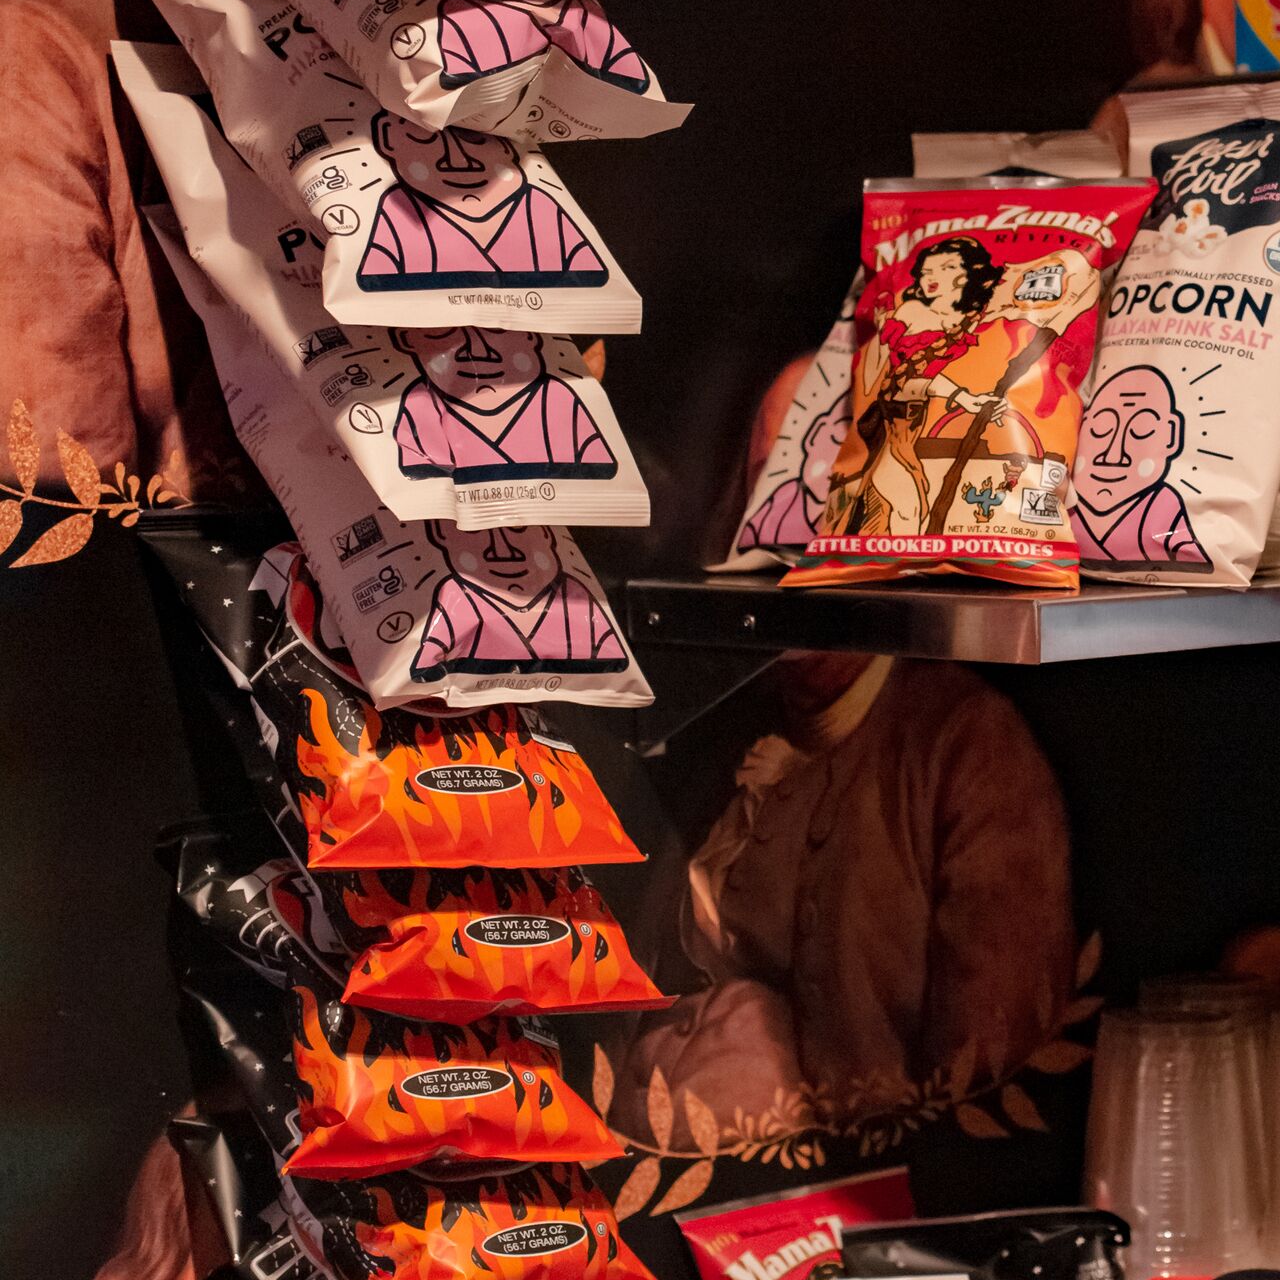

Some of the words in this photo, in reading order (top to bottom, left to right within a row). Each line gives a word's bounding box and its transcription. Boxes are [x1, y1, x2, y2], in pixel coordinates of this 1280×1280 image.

[1165, 269, 1214, 281] MINIMALLY
[1216, 271, 1274, 288] PROCESSED
[1108, 280, 1274, 328] OPCORN
[1164, 317, 1216, 338] PINK
[1219, 323, 1273, 350] SALT
[1125, 337, 1150, 346] EXTRA
[1151, 337, 1182, 347] VIRGIN
[1184, 338, 1234, 356] COCONUT
[1236, 347, 1255, 361] OIL
[324, 372, 349, 397] GLUTEN
[327, 388, 343, 403] FREE
[516, 485, 537, 500] (25g)
[948, 524, 964, 534] NET
[967, 525, 982, 534] WT.
[984, 526, 991, 534] 2
[992, 526, 1008, 535] OZ.
[1010, 526, 1039, 538] (56.7g)
[869, 538, 946, 554] COOKED
[952, 539, 1054, 557] POTATOES
[356, 582, 382, 601] GLUTEN
[359, 597, 376, 610] FREE
[431, 770, 454, 779] NET
[456, 770, 473, 778] WT.
[477, 770, 482, 778] 2
[485, 770, 502, 778] OZ.
[436, 780, 461, 789] (56.7
[463, 779, 504, 788] GRAMS)
[480, 921, 502, 929] NET
[504, 921, 522, 929] WT.
[524, 920, 530, 929] 2
[532, 920, 550, 929] OZ.
[484, 931, 508, 941] (56.7
[511, 930, 550, 940] GRAMS)
[418, 1075, 440, 1084] NET
[442, 1073, 461, 1082] WT.
[464, 1072, 470, 1081] 2
[472, 1071, 491, 1080] OZ.
[422, 1085, 447, 1095] (56.7
[450, 1082, 492, 1093] GRAMS)
[498, 1233, 520, 1243] NET
[520, 1230, 539, 1239] WT.
[541, 1228, 547, 1237] 2
[549, 1224, 567, 1234] OZ.
[503, 1241, 527, 1253] (56.7
[529, 1235, 568, 1249] GRAMS)
